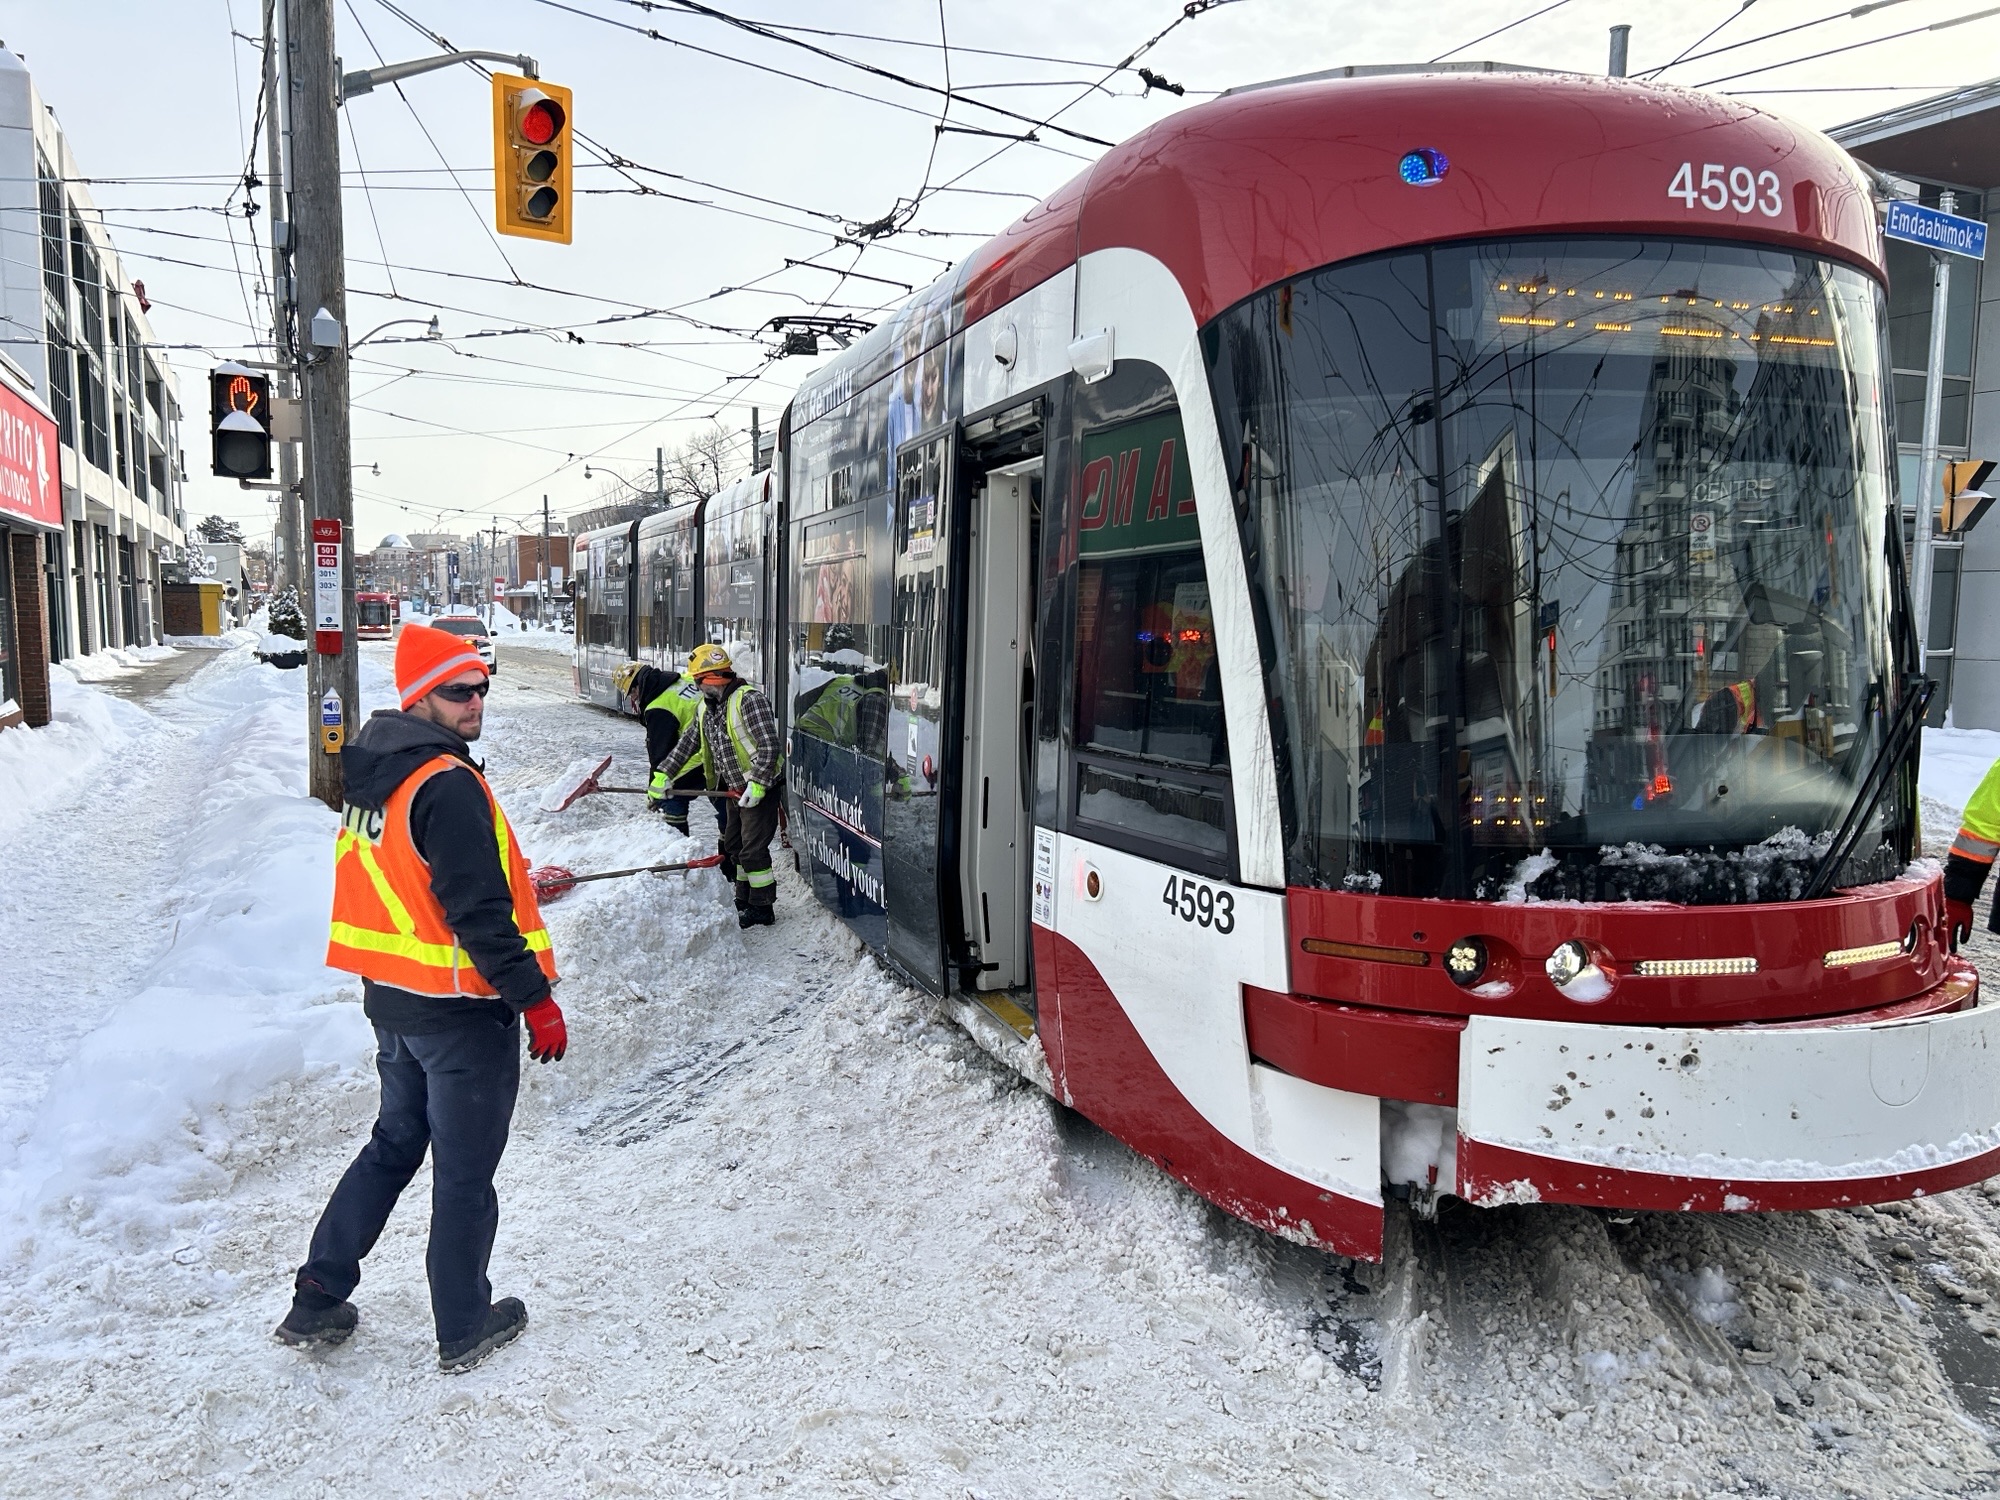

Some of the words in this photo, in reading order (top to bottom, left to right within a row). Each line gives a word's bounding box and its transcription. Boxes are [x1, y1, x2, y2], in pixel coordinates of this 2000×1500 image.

[1668, 162, 1783, 217] 4593
[1890, 205, 1973, 249] Emdaabiimok
[1974, 228, 1984, 241] Av
[321, 558, 335, 566] 503
[678, 683, 699, 699] TTC
[791, 764, 806, 798] Life
[807, 770, 840, 817] doesn't
[818, 830, 851, 881] should
[851, 863, 879, 903] your
[1163, 874, 1235, 935] 4593
